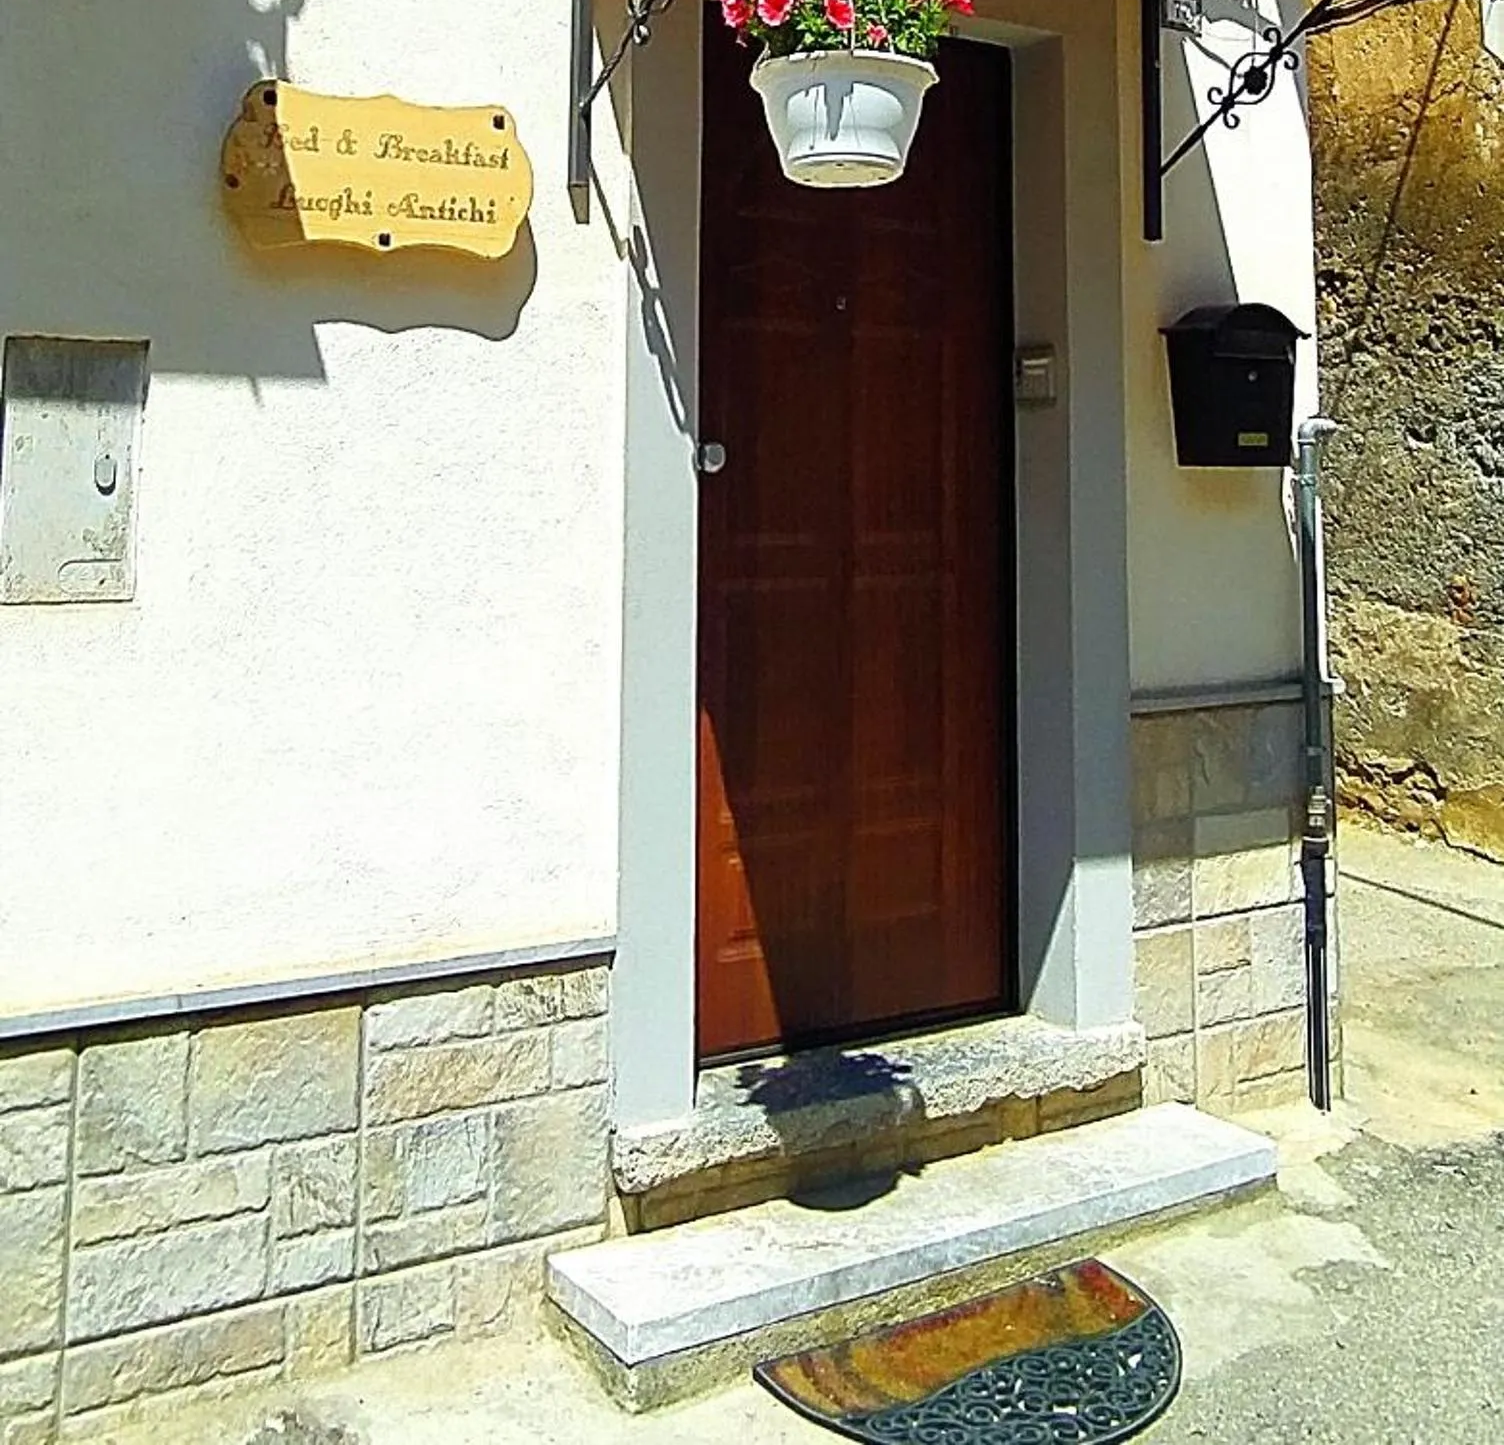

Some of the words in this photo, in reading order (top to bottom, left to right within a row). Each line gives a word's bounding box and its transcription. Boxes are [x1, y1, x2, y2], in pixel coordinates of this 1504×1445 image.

[261, 122, 320, 153] Bed
[336, 128, 357, 156] &
[373, 133, 509, 170] Breakfast
[270, 182, 374, 221] Luoghi
[387, 192, 497, 225] Antichi
